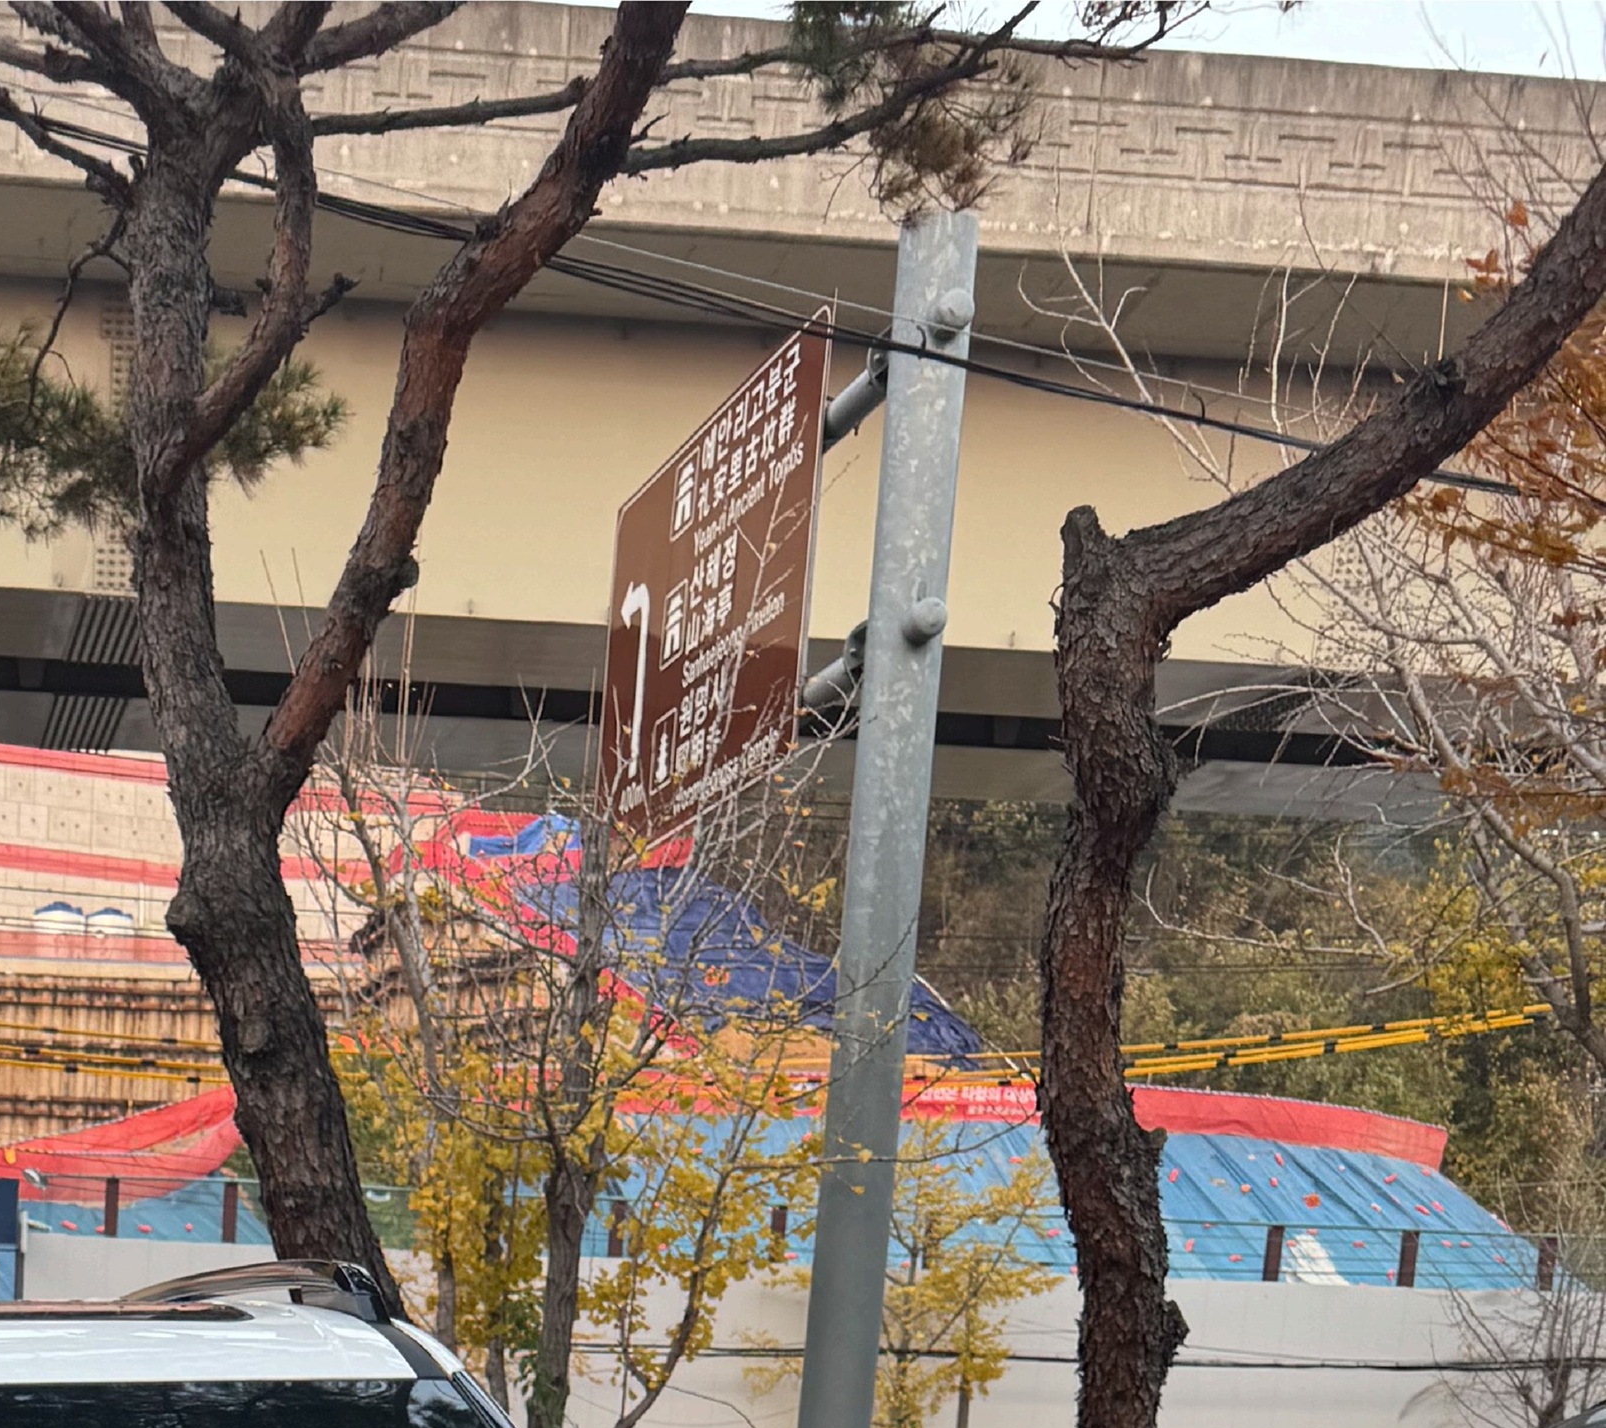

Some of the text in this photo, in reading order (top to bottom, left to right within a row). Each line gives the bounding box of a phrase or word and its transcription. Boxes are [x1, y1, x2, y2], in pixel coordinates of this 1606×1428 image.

[701, 342, 801, 470] 예안리고분군
[727, 472, 766, 526] Ancient
[769, 441, 805, 490] Tombs
[689, 529, 738, 609] 산해정
[685, 582, 734, 656] 山海亭
